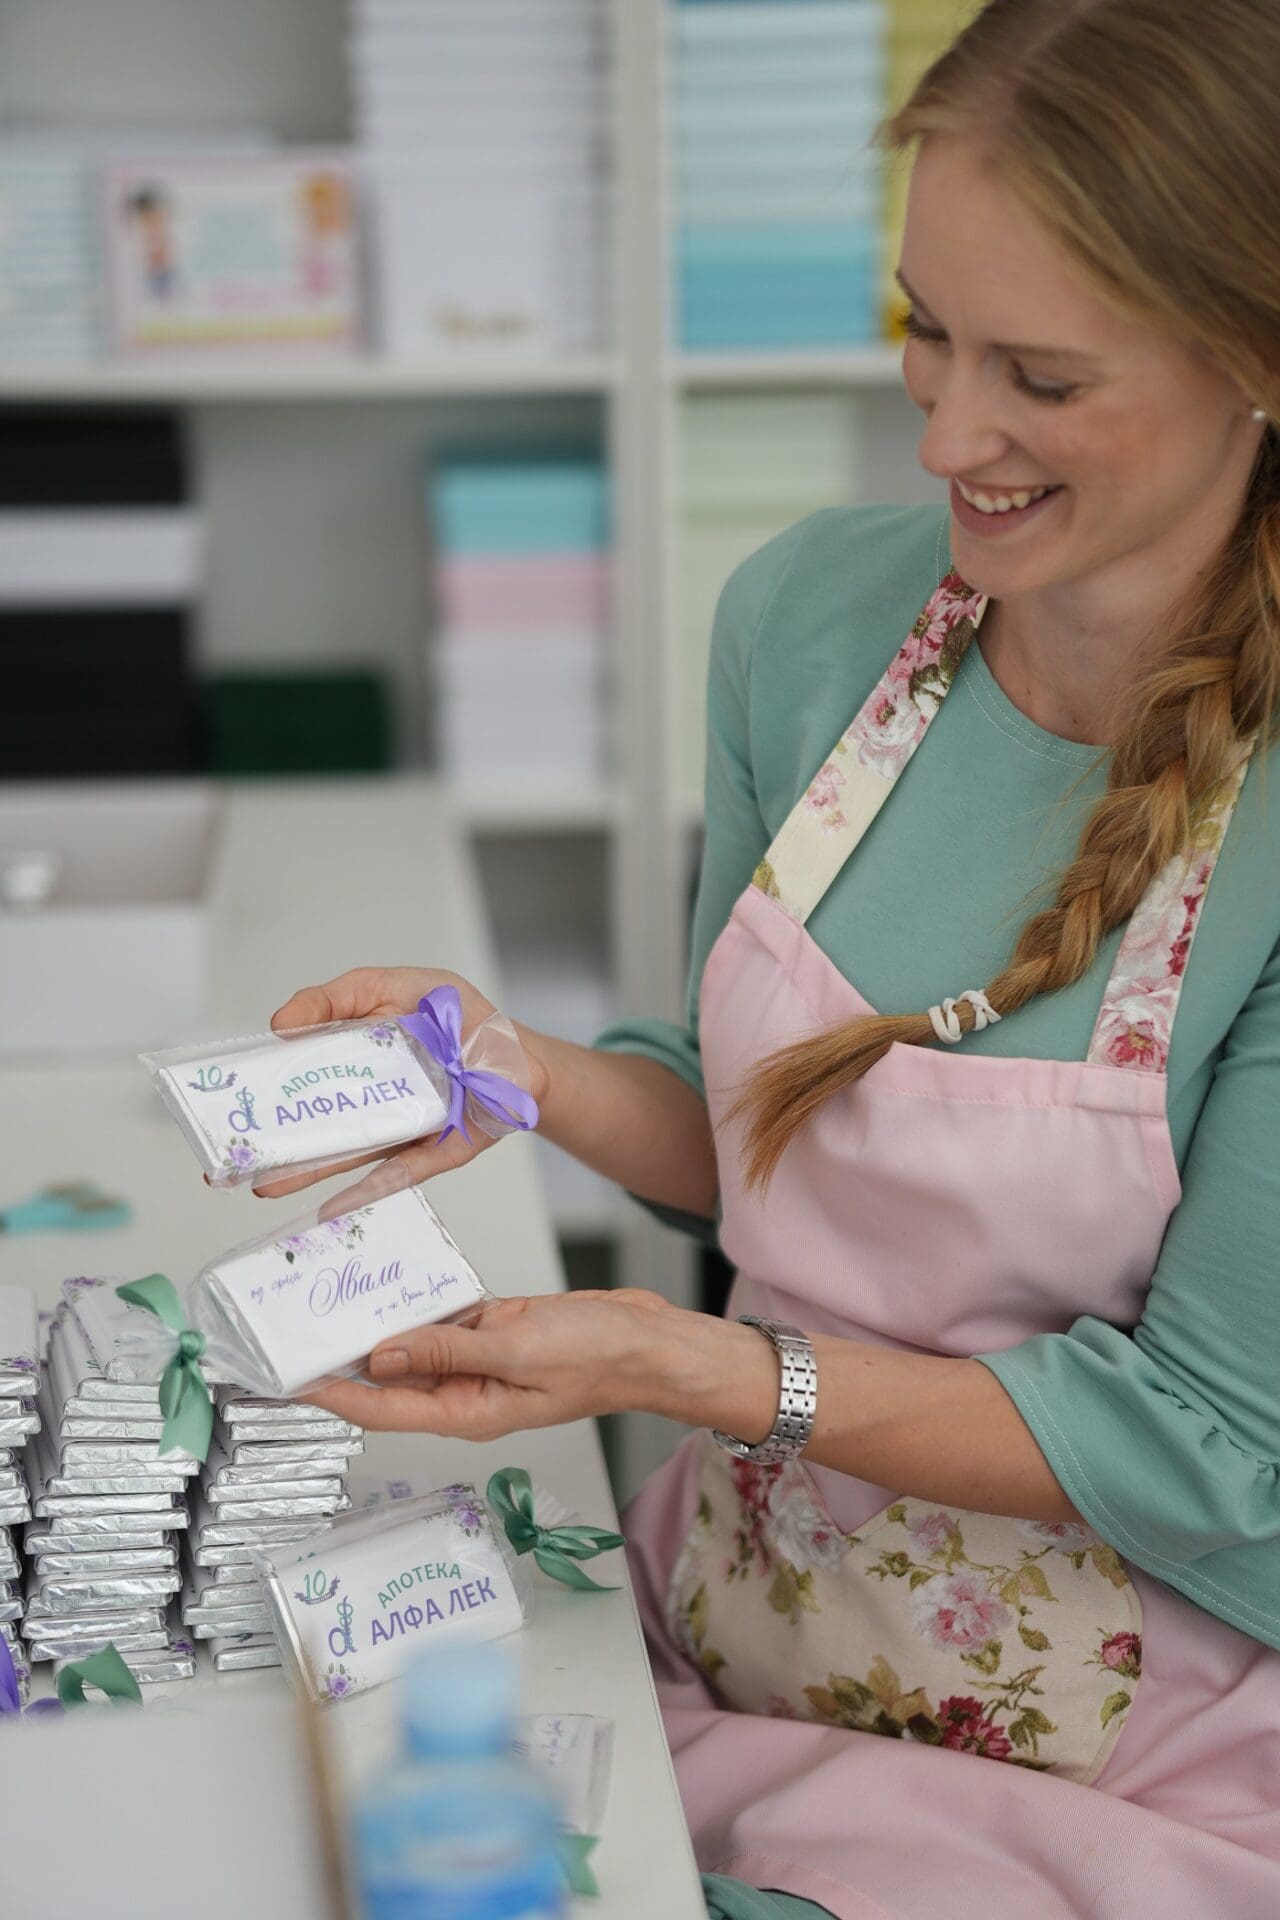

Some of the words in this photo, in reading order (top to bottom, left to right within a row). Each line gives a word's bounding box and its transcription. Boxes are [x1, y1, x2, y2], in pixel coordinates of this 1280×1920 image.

[196, 1066, 222, 1088] 10
[281, 1064, 375, 1099] АПОТЕКА
[275, 1089, 358, 1127] АЛФА
[362, 1076, 416, 1108] ЛЕК
[308, 1254, 404, 1318] Хвала
[303, 1569, 327, 1600] 10
[377, 1561, 463, 1609] АПОТЕКА
[370, 1598, 445, 1647] АЛФА
[449, 1575, 498, 1615] ЛЕК
